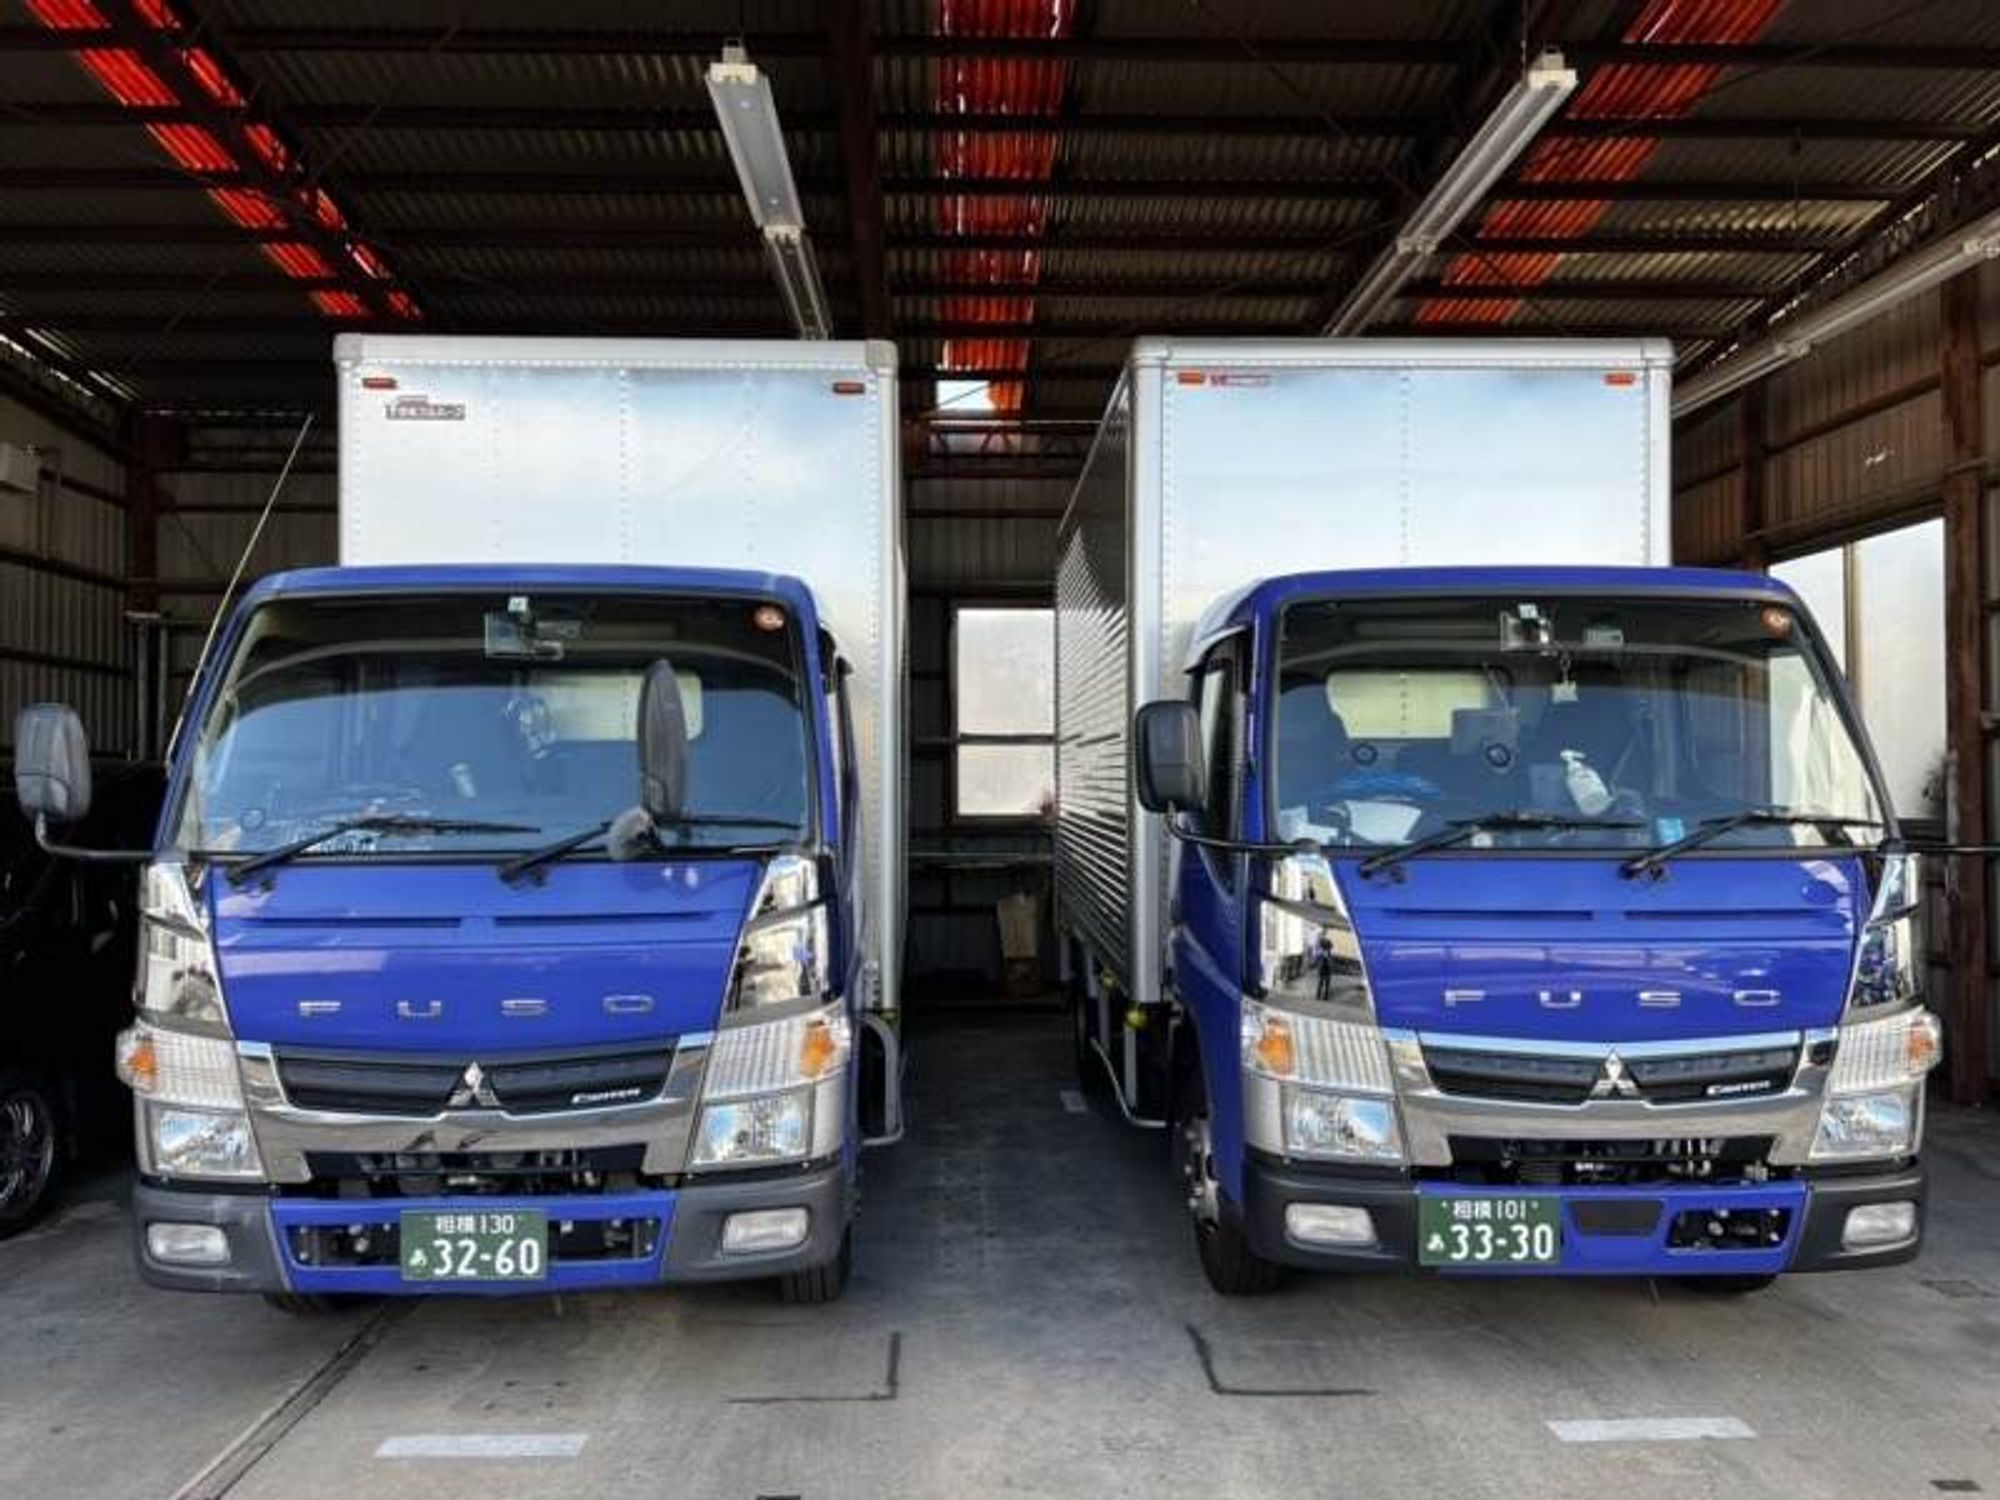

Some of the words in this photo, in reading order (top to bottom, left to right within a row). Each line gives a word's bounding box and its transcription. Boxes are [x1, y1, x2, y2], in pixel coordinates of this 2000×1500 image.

[299, 994, 654, 1017] FUSO
[1445, 989, 1781, 1009] FUSO
[1497, 1200, 1526, 1220] 101
[480, 1214, 514, 1235] 130
[1450, 1223, 1554, 1260] 33-30
[432, 1238, 540, 1275] 32-60
